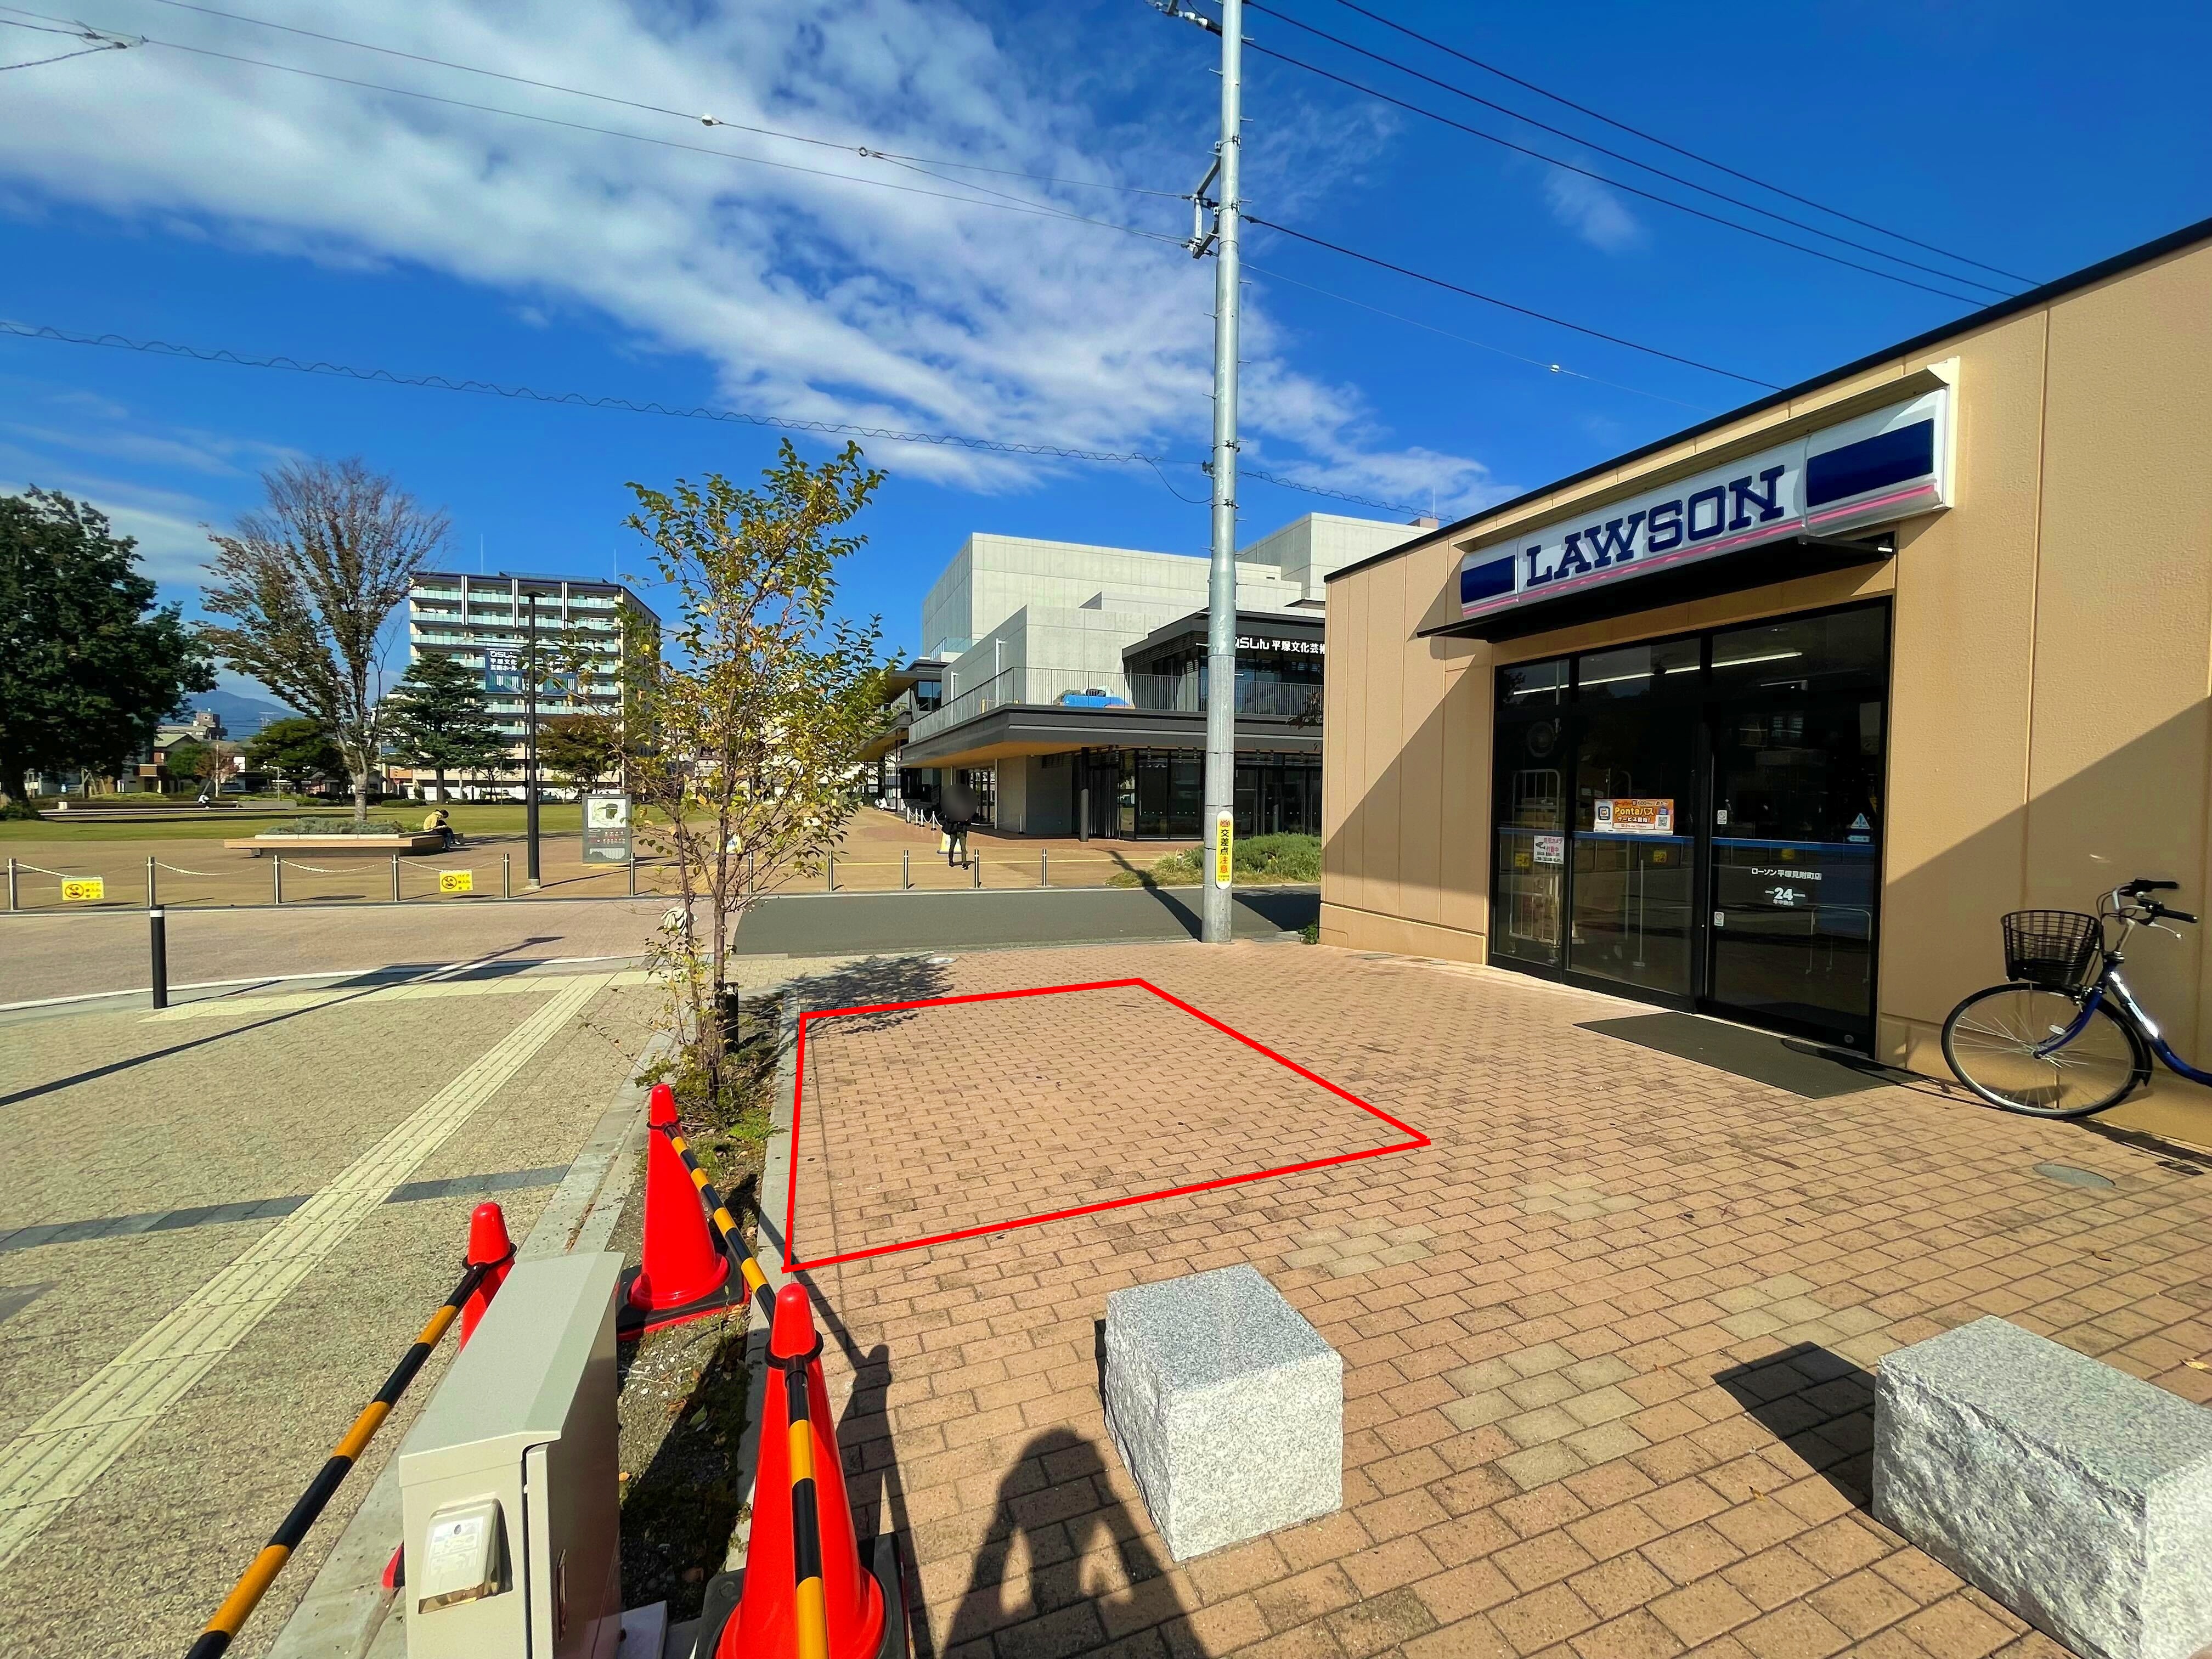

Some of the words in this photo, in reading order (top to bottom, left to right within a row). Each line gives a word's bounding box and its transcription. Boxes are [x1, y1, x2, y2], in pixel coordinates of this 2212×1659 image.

[1526, 465, 1785, 586] LAWSON
[1615, 806, 1654, 816] Pontaパス
[1220, 829, 1229, 873] 交差点注意
[1774, 887, 1793, 900] 24
